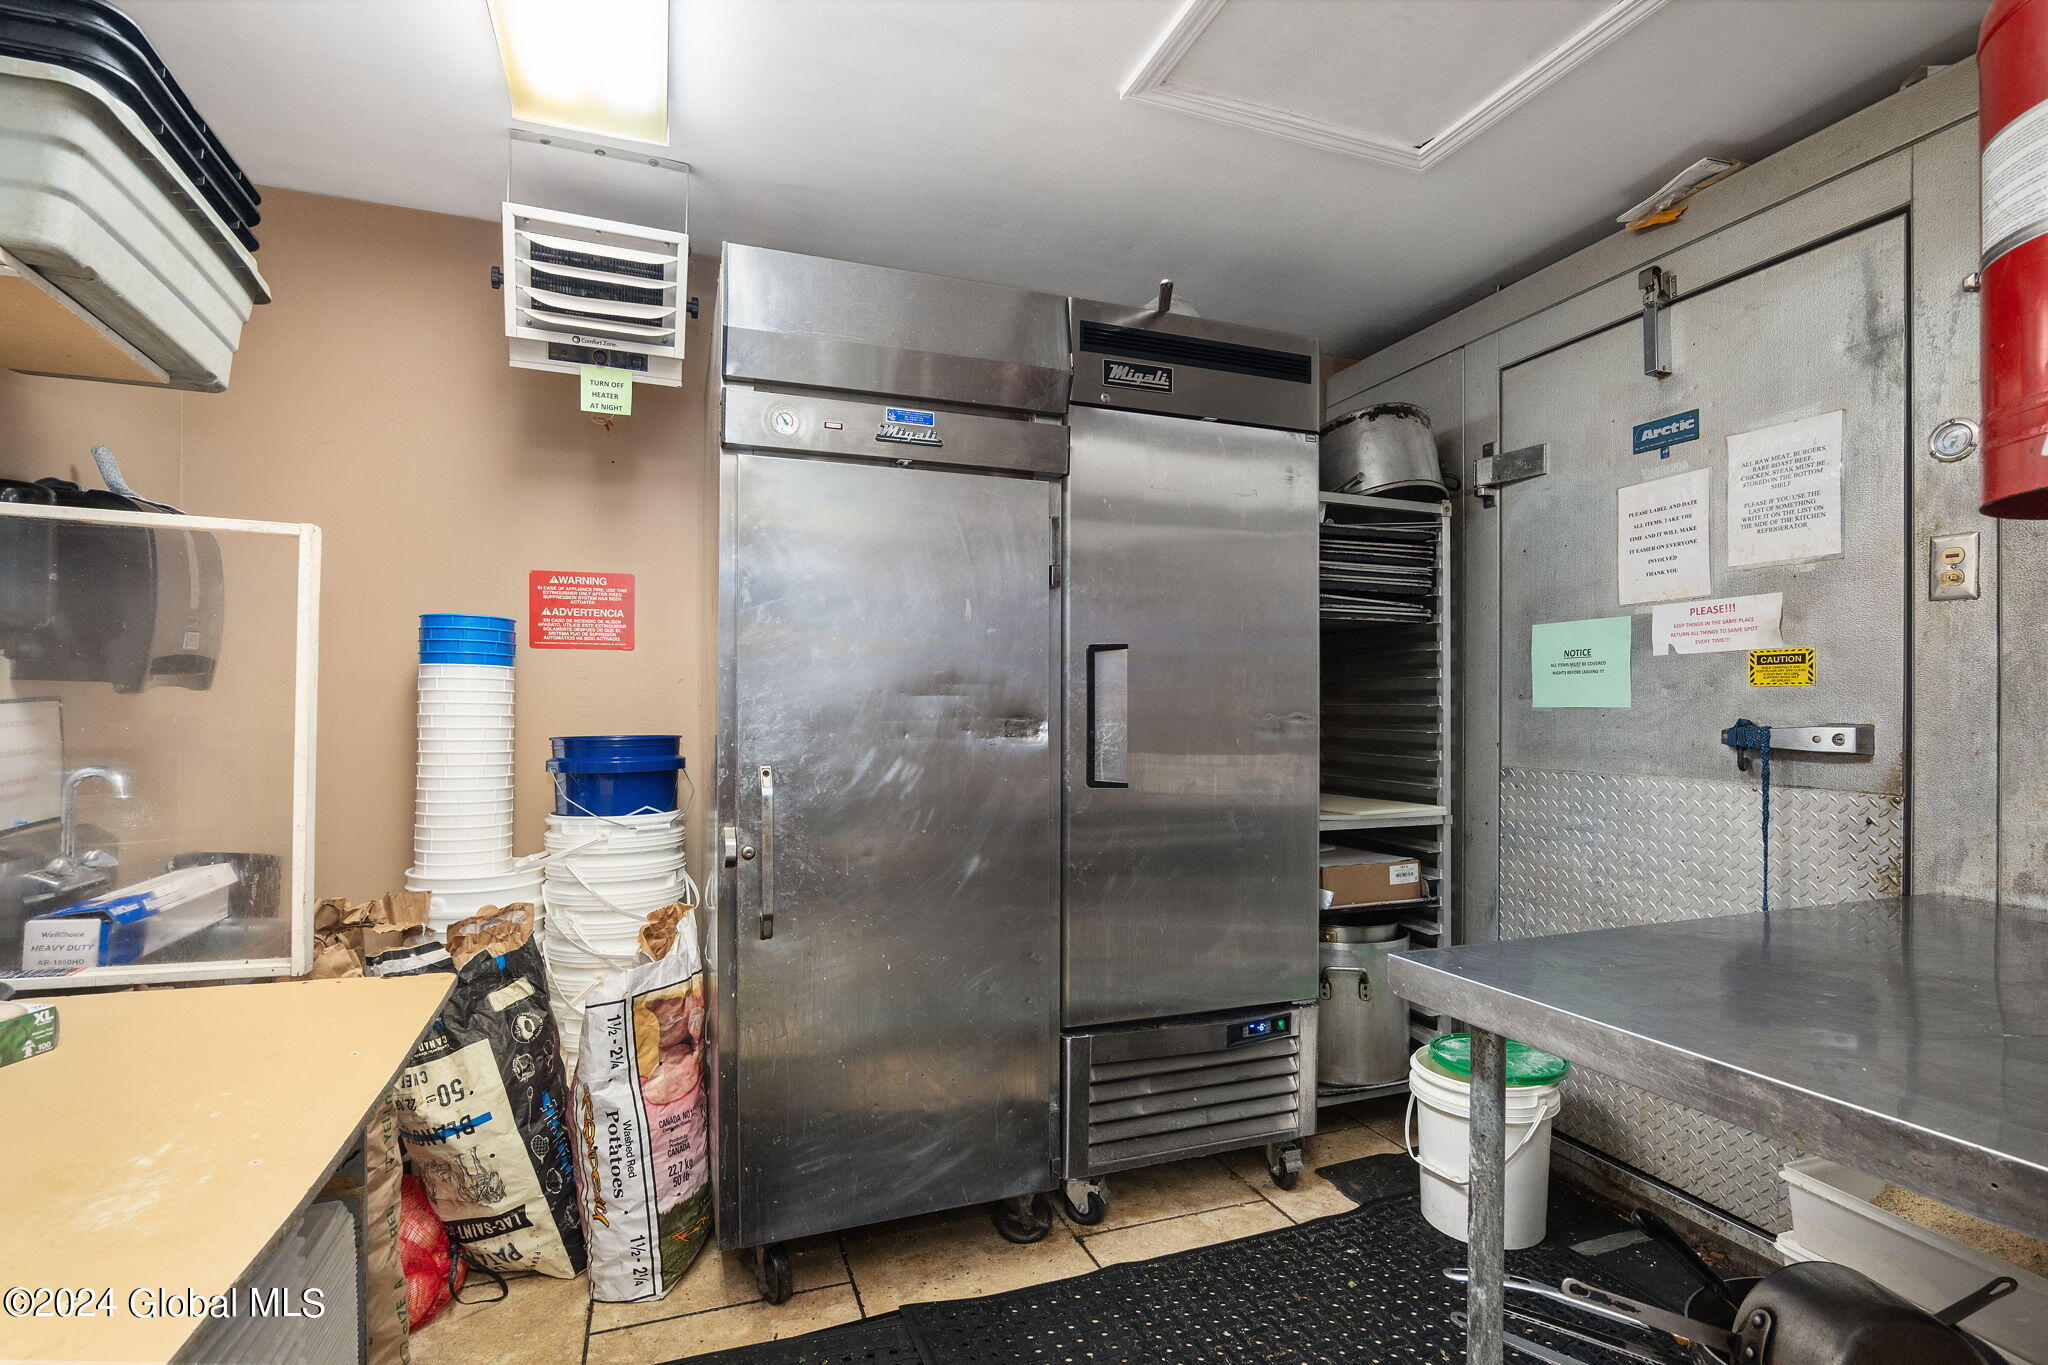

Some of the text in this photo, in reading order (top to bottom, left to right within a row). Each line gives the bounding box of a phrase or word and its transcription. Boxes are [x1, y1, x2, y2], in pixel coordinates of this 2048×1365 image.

[581, 338, 602, 346] Comfort
[1108, 364, 1170, 386] Migali
[590, 379, 610, 387] TURN
[592, 391, 618, 400] HEATER
[879, 423, 940, 443] Migali
[1641, 418, 1695, 441] Arctic
[1752, 464, 1770, 472] RARE
[1771, 460, 1793, 468] ROAST
[1772, 468, 1794, 476] STEAK
[1795, 462, 1814, 471] MUST
[1743, 479, 1768, 488] STORED
[1779, 473, 1791, 482] THE
[1793, 468, 1824, 478] BOTTOM
[1770, 480, 1792, 489] SHELF
[1743, 500, 1768, 508] PLEASE
[1807, 490, 1822, 498] THE
[1776, 498, 1816, 510] SOMETHING
[1742, 514, 1764, 522] WRITE
[1771, 510, 1781, 518] ON
[1782, 508, 1795, 516] THE
[1797, 506, 1812, 514] LIST
[1813, 504, 1824, 512] ON
[1741, 522, 1752, 530] THE
[1754, 520, 1768, 528] SIDE
[1780, 516, 1794, 524] THE
[1795, 511, 1826, 522] KITCHEN
[1756, 522, 1808, 534] REFRIGERATOR
[1636, 545, 1656, 553] EASIER
[1666, 539, 1697, 548] EVERYONE
[1648, 555, 1677, 563] INVOLVED
[558, 576, 608, 586] WARNING
[552, 608, 624, 618] ADVERTENCIA
[1689, 603, 1736, 617] PLEASE!!!
[1686, 620, 1704, 628] THINGS
[1700, 628, 1719, 636] THINGS
[1727, 626, 1742, 634] SAME
[1564, 648, 1592, 659] NOTICE
[1760, 655, 1802, 664] CAUTION
[41, 931, 85, 939] WellChoice
[30, 944, 95, 952] HEAVY DUTY
[33, 1010, 55, 1022] XL
[37, 1041, 52, 1051] 100
[418, 1035, 448, 1052] CANAD
[437, 1079, 464, 1107] 50
[659, 1114, 681, 1129] CANADA
[605, 1110, 624, 1198] Potatoes
[623, 1120, 638, 1178] Washed Red
[668, 1143, 690, 1158] CANADA
[673, 1175, 682, 1188] 50
